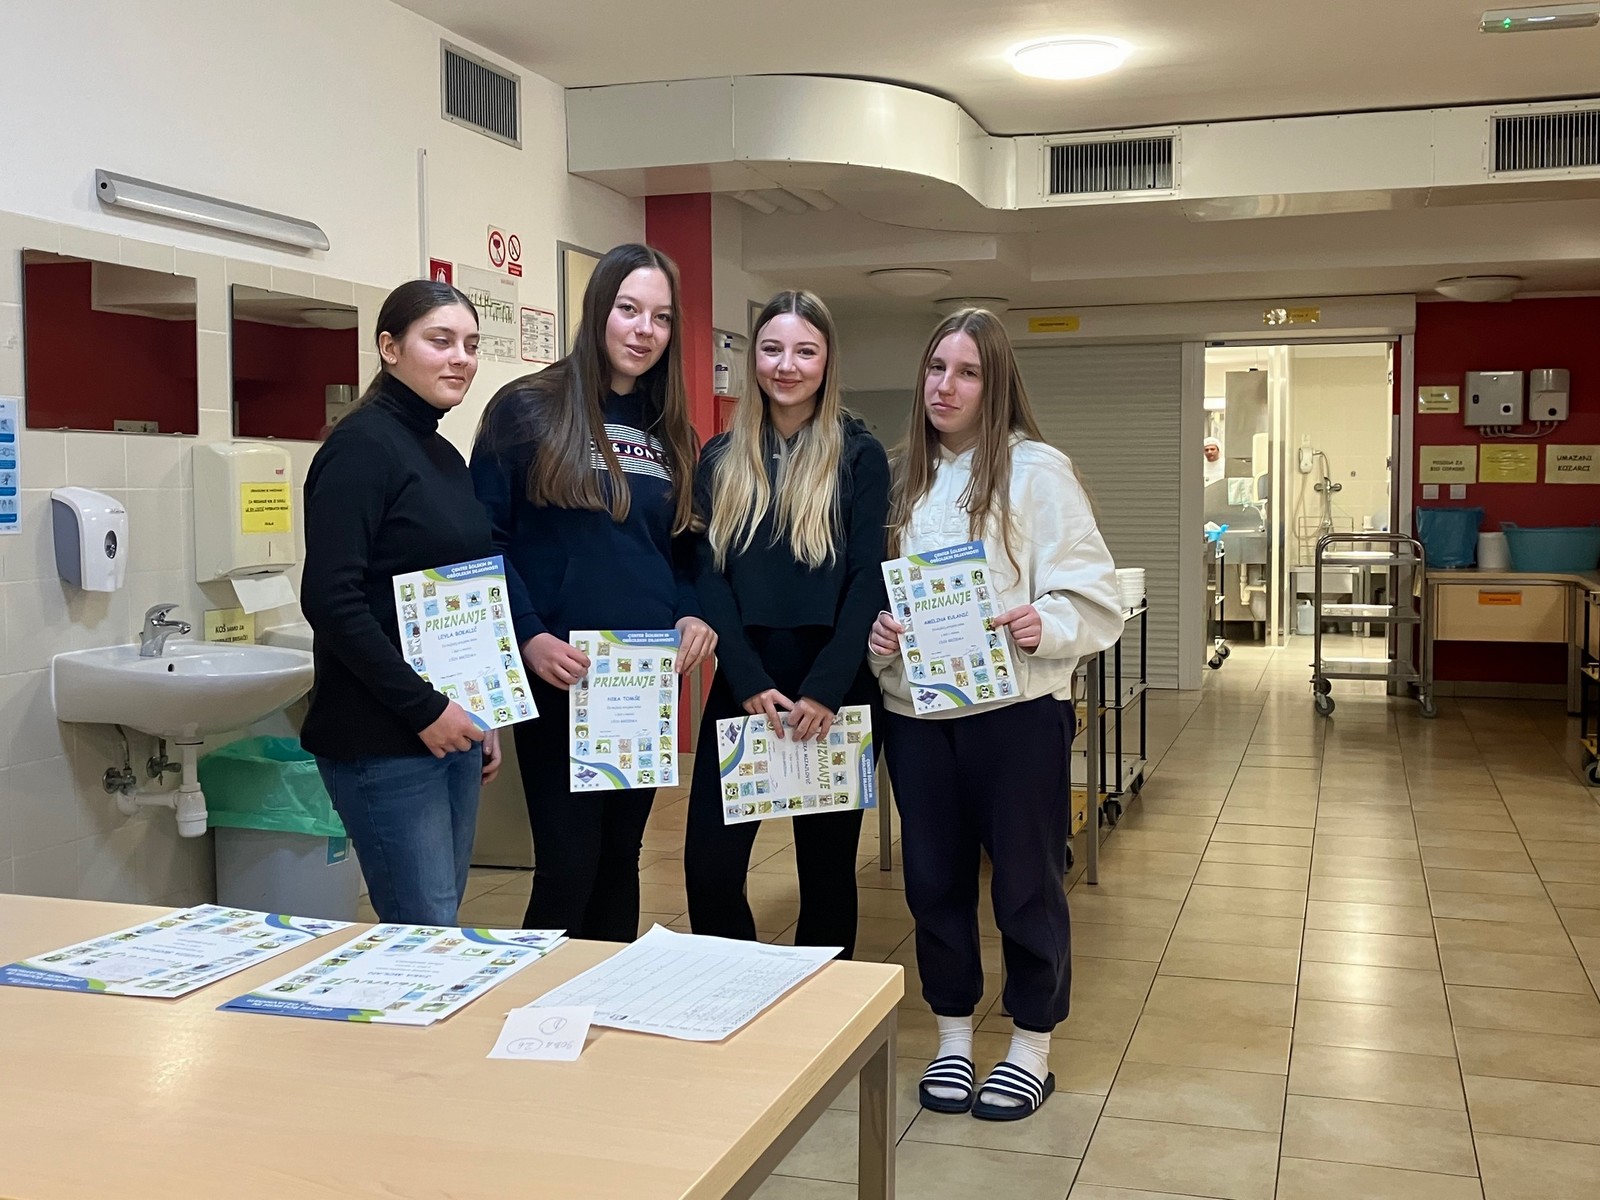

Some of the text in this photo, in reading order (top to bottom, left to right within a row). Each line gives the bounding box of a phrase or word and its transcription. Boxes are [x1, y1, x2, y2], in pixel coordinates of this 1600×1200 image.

[611, 443, 620, 453] &
[914, 590, 972, 612] PRIZNANJE
[215, 624, 227, 633] KOŠ
[425, 608, 487, 632] PRIZNANJE
[593, 675, 656, 688] PRIZNANJE
[816, 737, 831, 790] RIZNANJE
